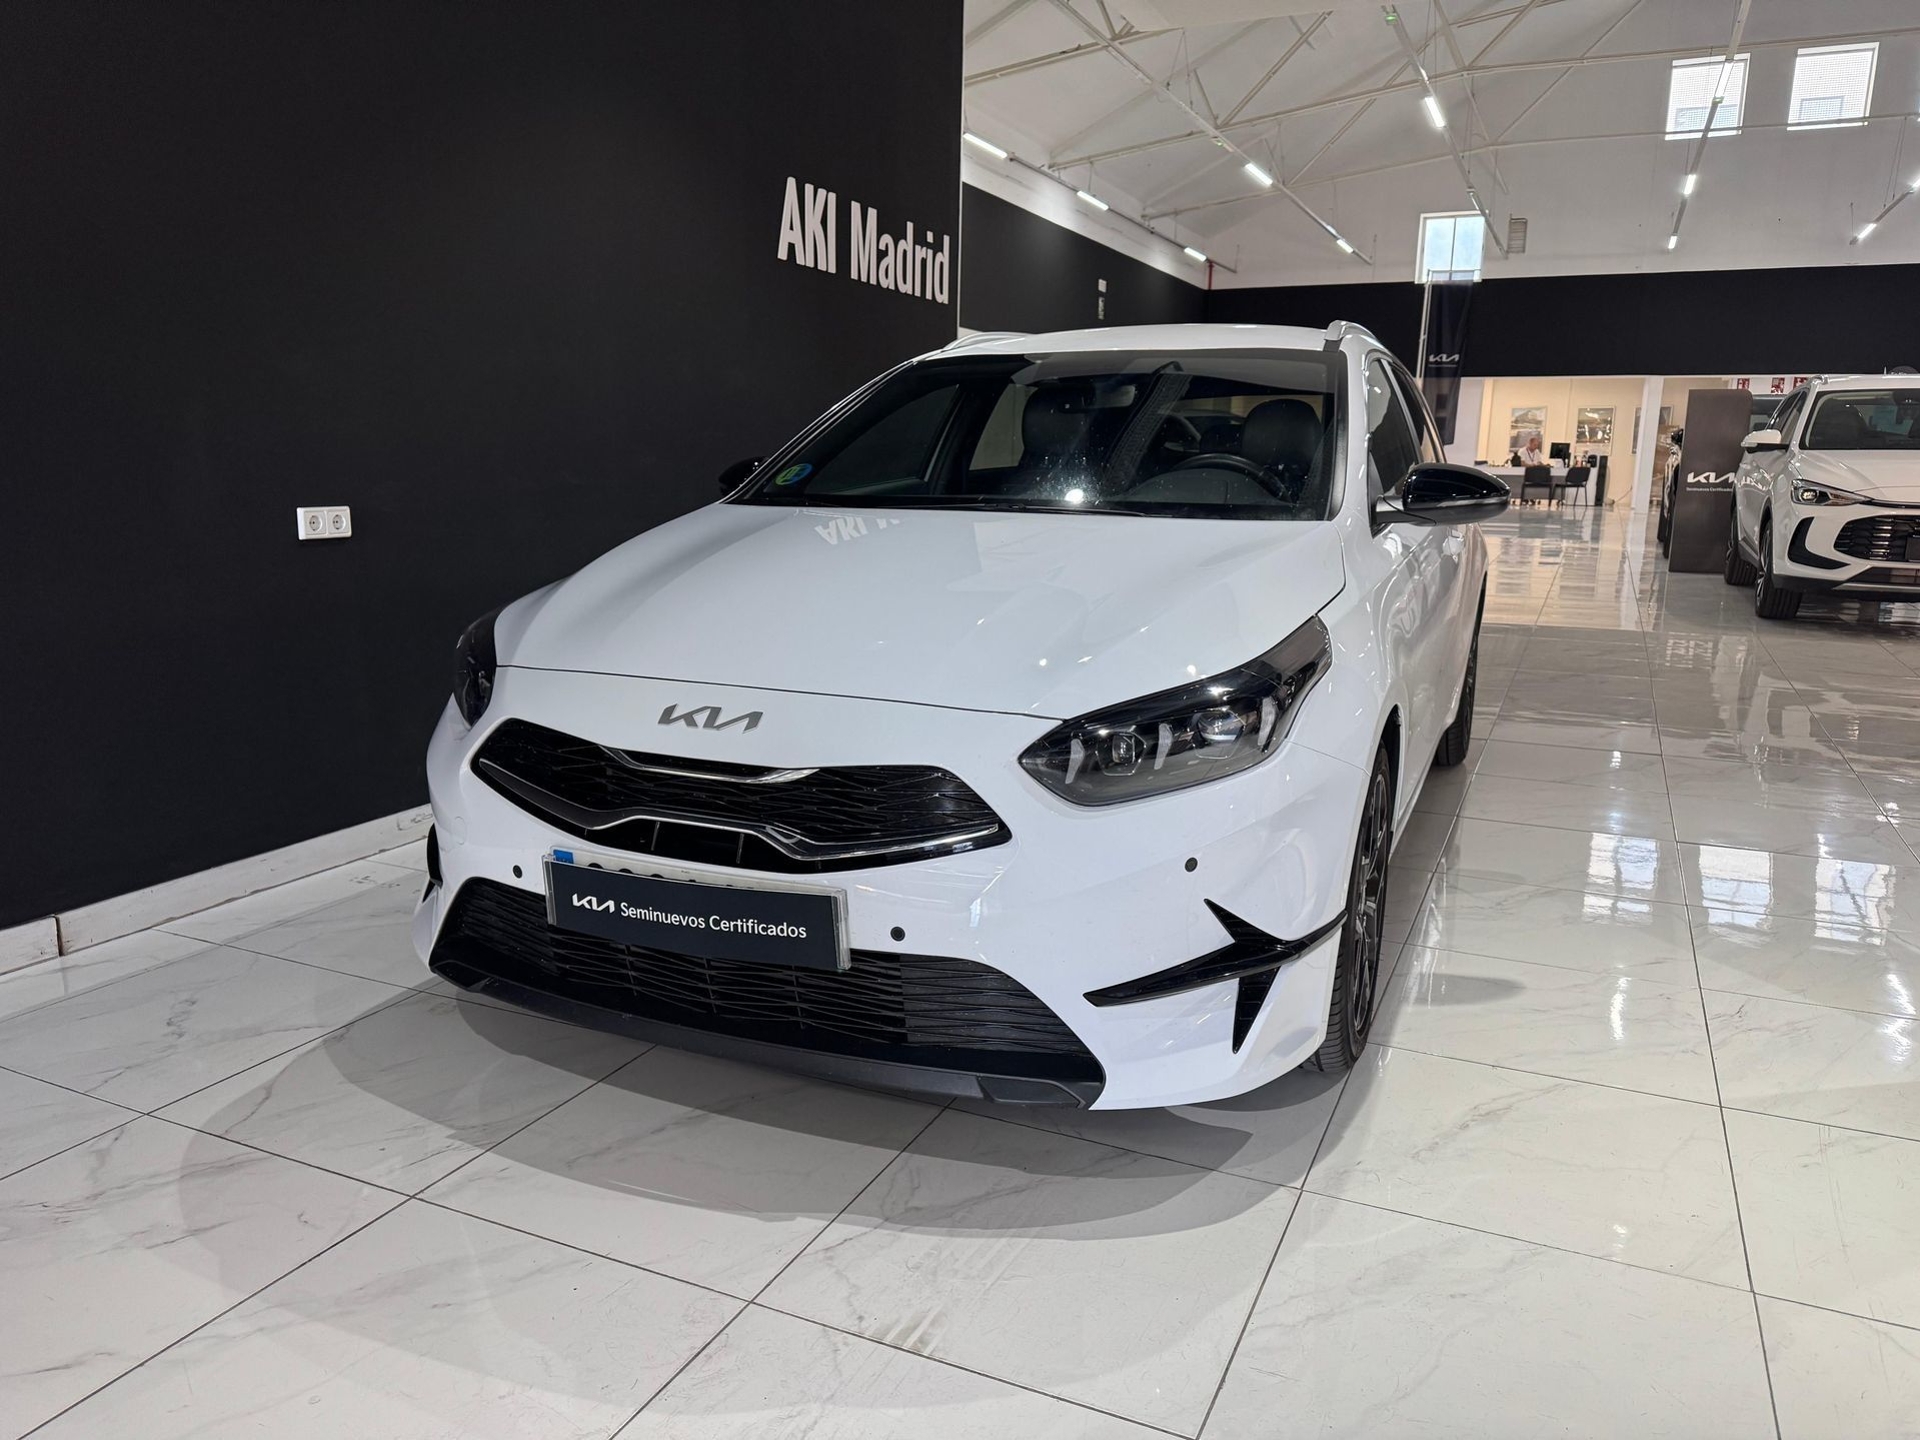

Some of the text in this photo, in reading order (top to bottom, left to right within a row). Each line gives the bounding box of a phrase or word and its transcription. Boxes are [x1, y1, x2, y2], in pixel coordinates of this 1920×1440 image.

[777, 176, 950, 305] AKI Madrid
[1429, 353, 1460, 362] KIA
[1687, 472, 1736, 483] KIA
[658, 703, 764, 734] KIA
[572, 893, 807, 938] KIA Seminuevos Certificados
